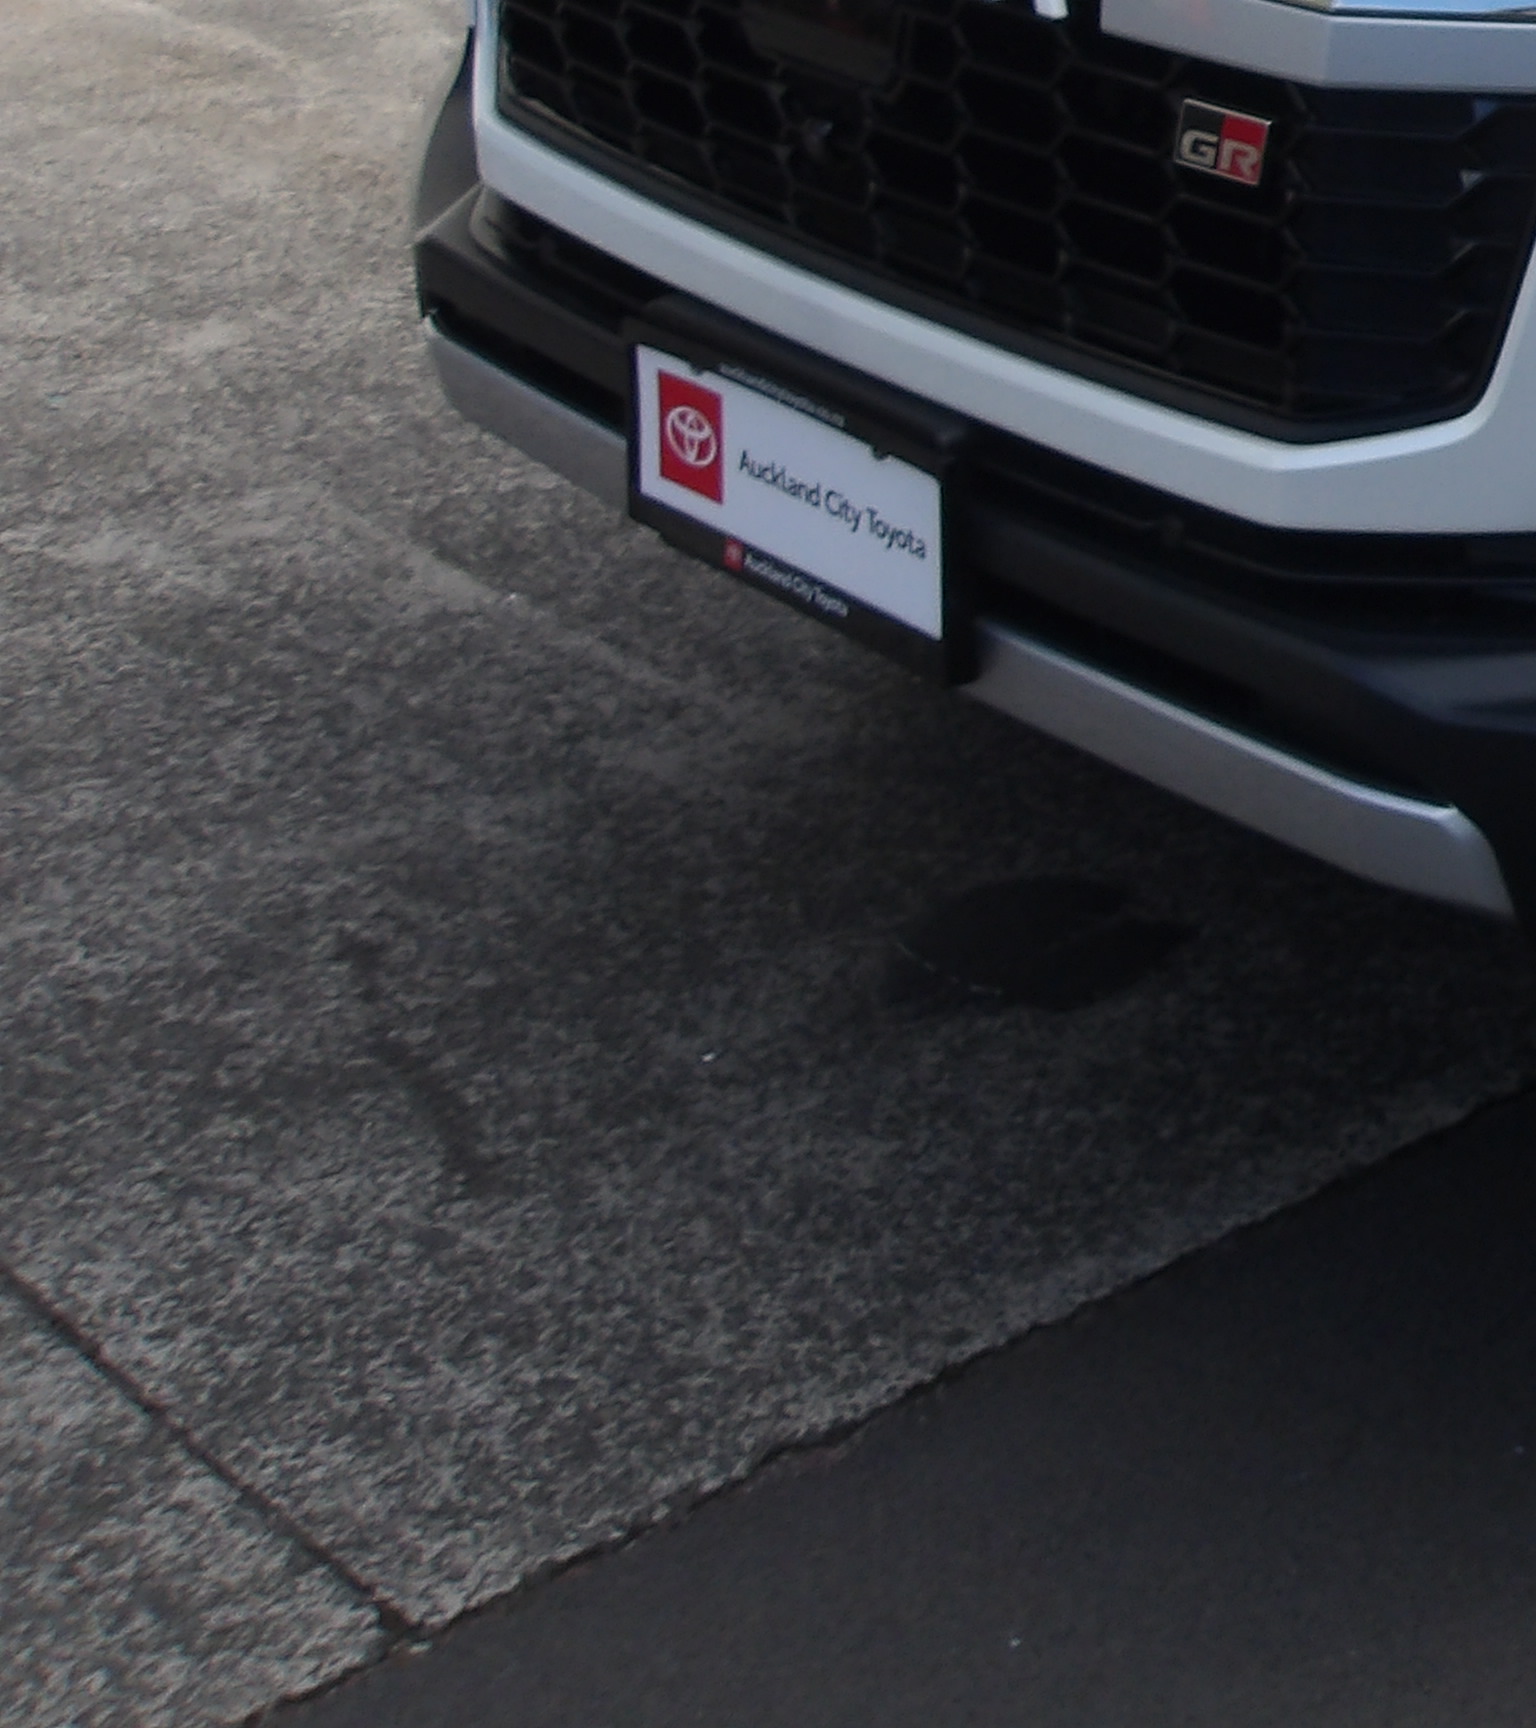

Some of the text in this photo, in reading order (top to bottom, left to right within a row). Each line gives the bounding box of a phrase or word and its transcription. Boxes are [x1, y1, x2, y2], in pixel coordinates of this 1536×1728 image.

[1180, 129, 1259, 178] GR
[739, 449, 927, 560] Auckland City Toyota
